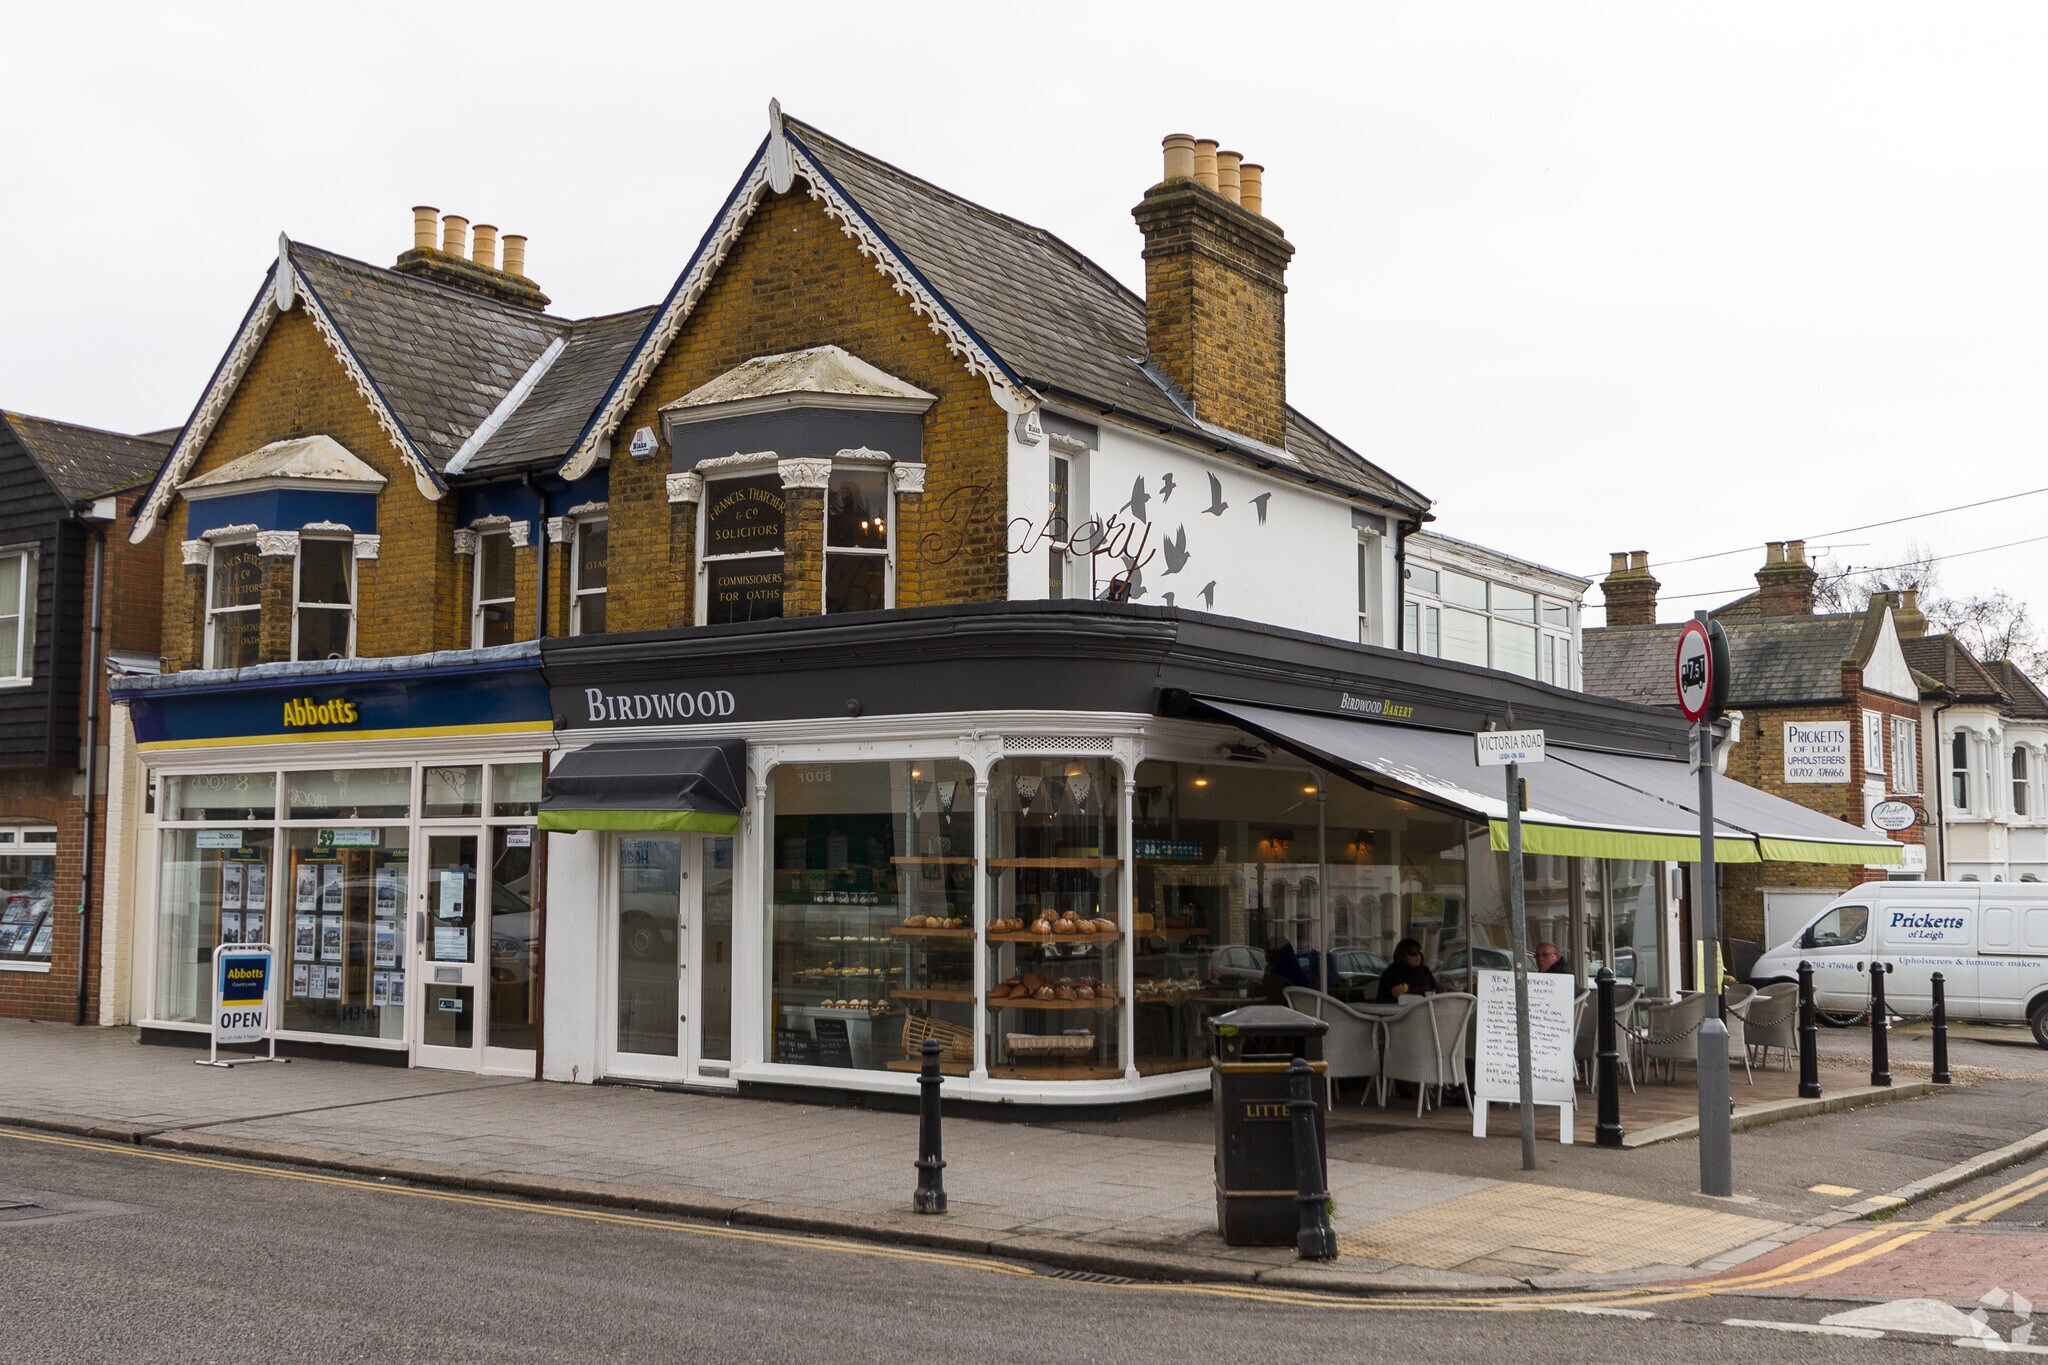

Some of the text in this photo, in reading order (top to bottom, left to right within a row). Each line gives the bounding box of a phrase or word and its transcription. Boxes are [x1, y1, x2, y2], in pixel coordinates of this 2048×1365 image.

[749, 487, 787, 514] THATCHER
[715, 524, 779, 540] SOLICITORS
[919, 482, 1157, 595] Bakery
[718, 573, 783, 587] COMMISSIONERS
[720, 589, 780, 602] FOR OATHS
[283, 697, 358, 727] Abbotts
[585, 688, 736, 722] BIRDWOOD
[1340, 693, 1414, 719] BIRDWOOD BAKERY
[1479, 734, 1543, 751] VICTORIA ROAD
[1789, 726, 1845, 743] PRICKETTS
[1788, 756, 1846, 765] UPHOLSTERERS
[1789, 768, 1844, 777] 01702 476966
[319, 829, 336, 848] 59
[1890, 912, 1964, 928] Pricketts
[1908, 930, 1944, 941] of Leigh
[1812, 961, 1854, 970] 702 476966
[1899, 957, 1952, 966] Upholsterers
[1966, 958, 2004, 967] furniture
[2008, 959, 2041, 968] makers
[228, 968, 264, 979] Abbotts
[1492, 975, 1509, 984] NEW
[220, 1011, 262, 1029] OPEN
[1246, 1103, 1291, 1117] LITTE
